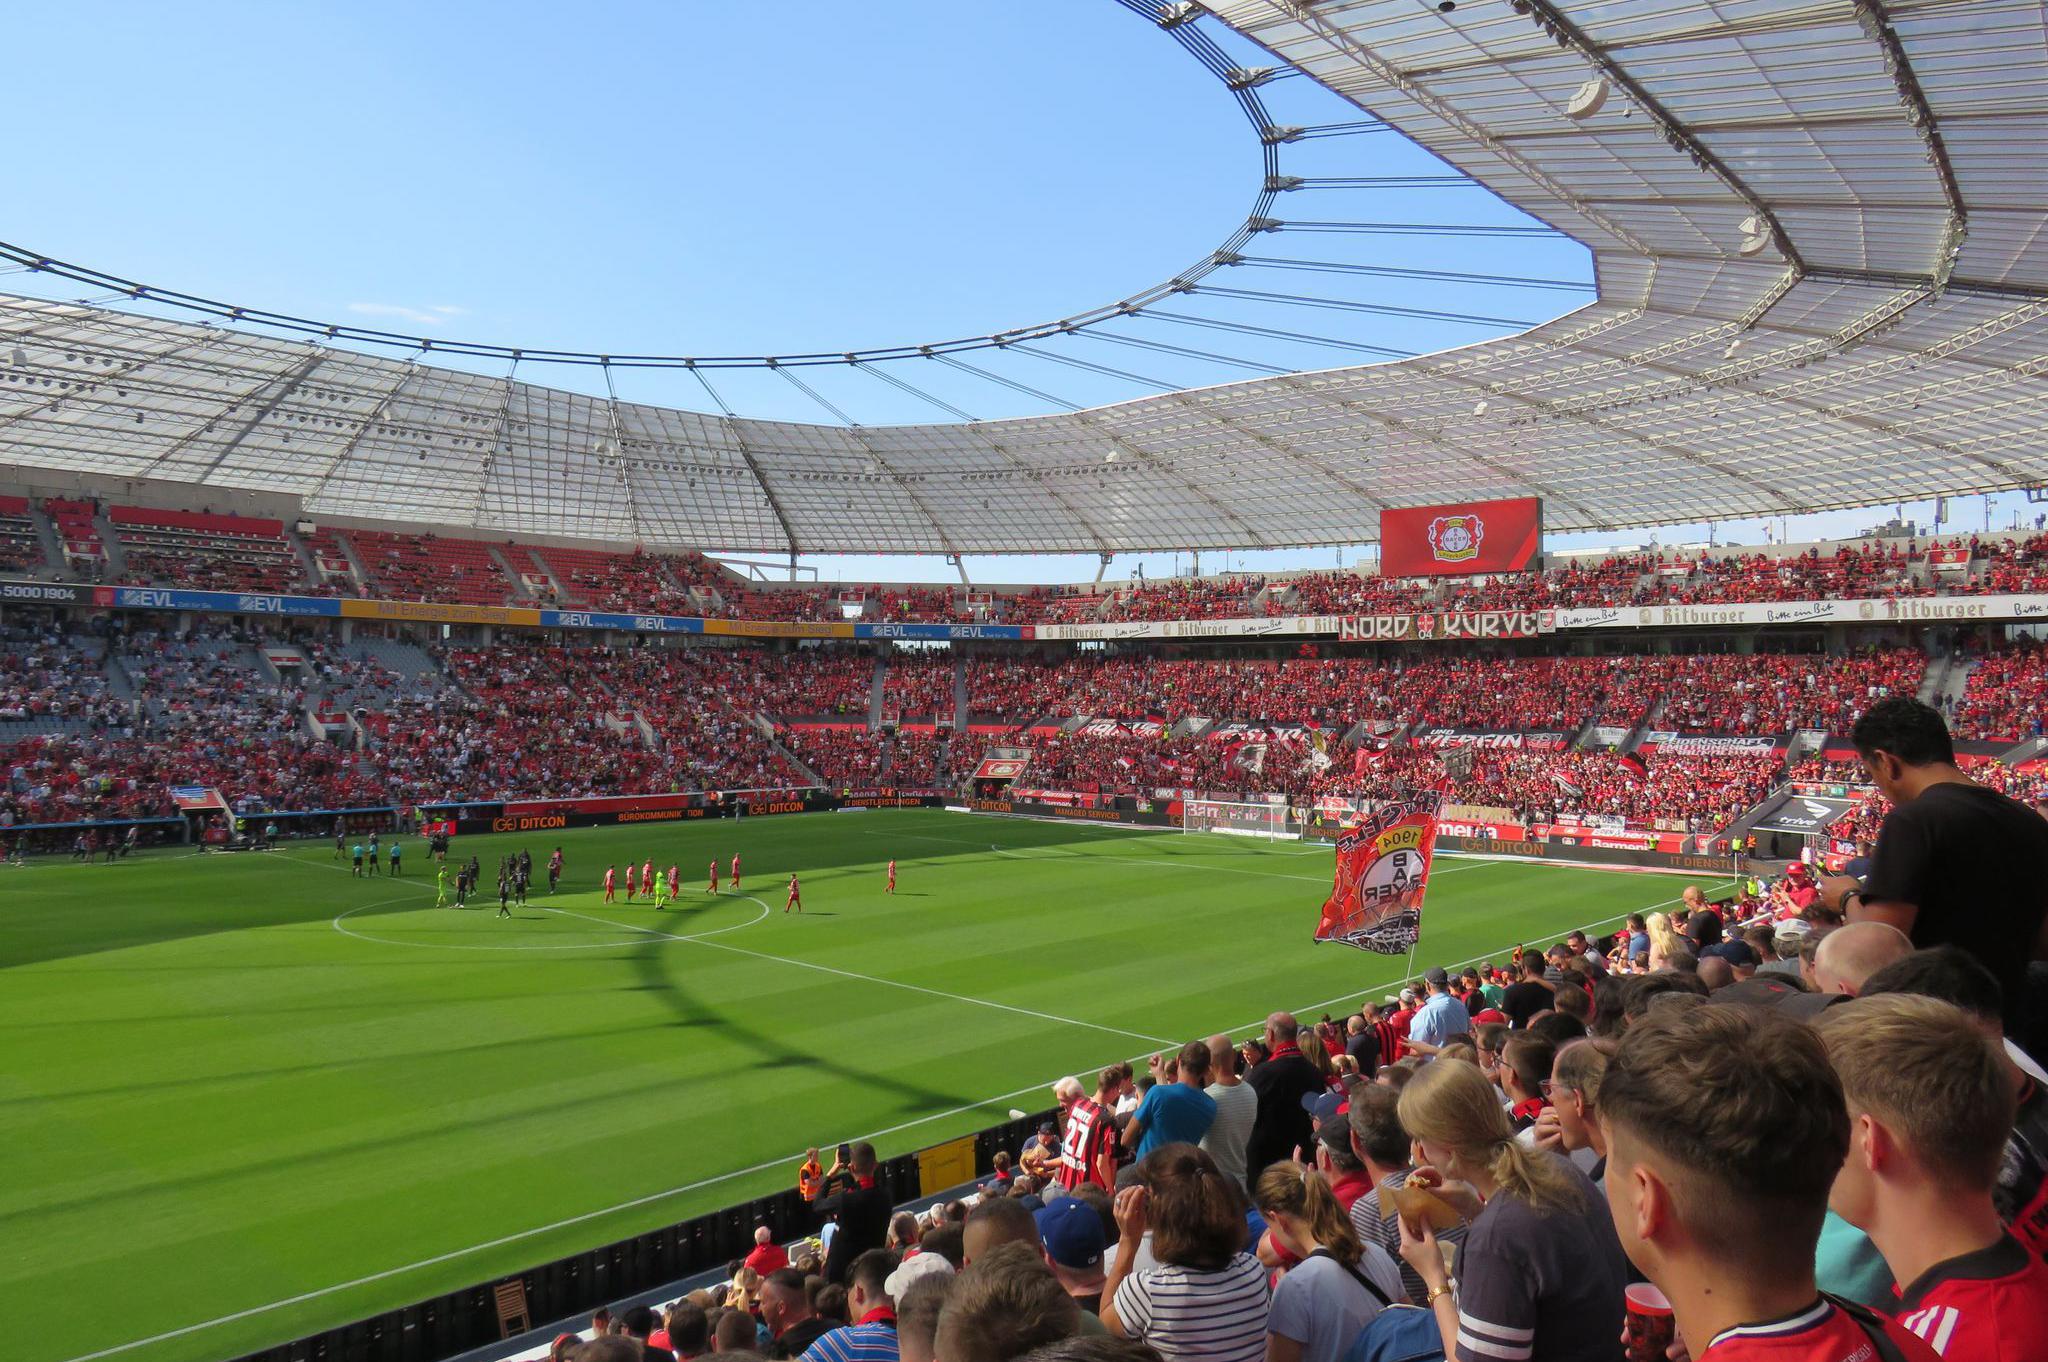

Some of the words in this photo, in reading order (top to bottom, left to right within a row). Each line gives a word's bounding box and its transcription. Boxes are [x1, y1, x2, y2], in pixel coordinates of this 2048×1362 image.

[4, 585, 42, 599] 5000
[44, 588, 76, 600] 1904
[141, 591, 176, 607] EVL
[255, 597, 286, 612] EVL
[1882, 600, 1987, 619] Bitburger
[2013, 602, 2043, 616] Bitte
[1662, 607, 1745, 625] Bitburger
[1767, 610, 1791, 622] Bitte
[1813, 603, 1834, 614] Bit
[570, 614, 594, 627] EVL
[645, 618, 667, 630] EVL
[1443, 612, 1538, 638] KURVE
[884, 626, 907, 637] EVL
[961, 626, 985, 638] EVL
[1059, 626, 1104, 639] Bitburger
[1177, 622, 1229, 636] Bitburger
[1341, 616, 1411, 640] NORD
[1418, 630, 1433, 640] 04
[1430, 728, 1455, 736] UND
[769, 801, 804, 813] DITCON
[980, 801, 1012, 812] DITCON
[618, 808, 704, 821] BÜROKOMMUNIKTION
[1055, 808, 1087, 818] MANAGED
[1088, 810, 1121, 820] SERVICES
[520, 815, 566, 829] DITCON
[1437, 823, 1498, 840] mena
[1490, 840, 1544, 856] DITCON
[1670, 856, 1681, 866] IT
[1064, 1118, 1090, 1159] 27
